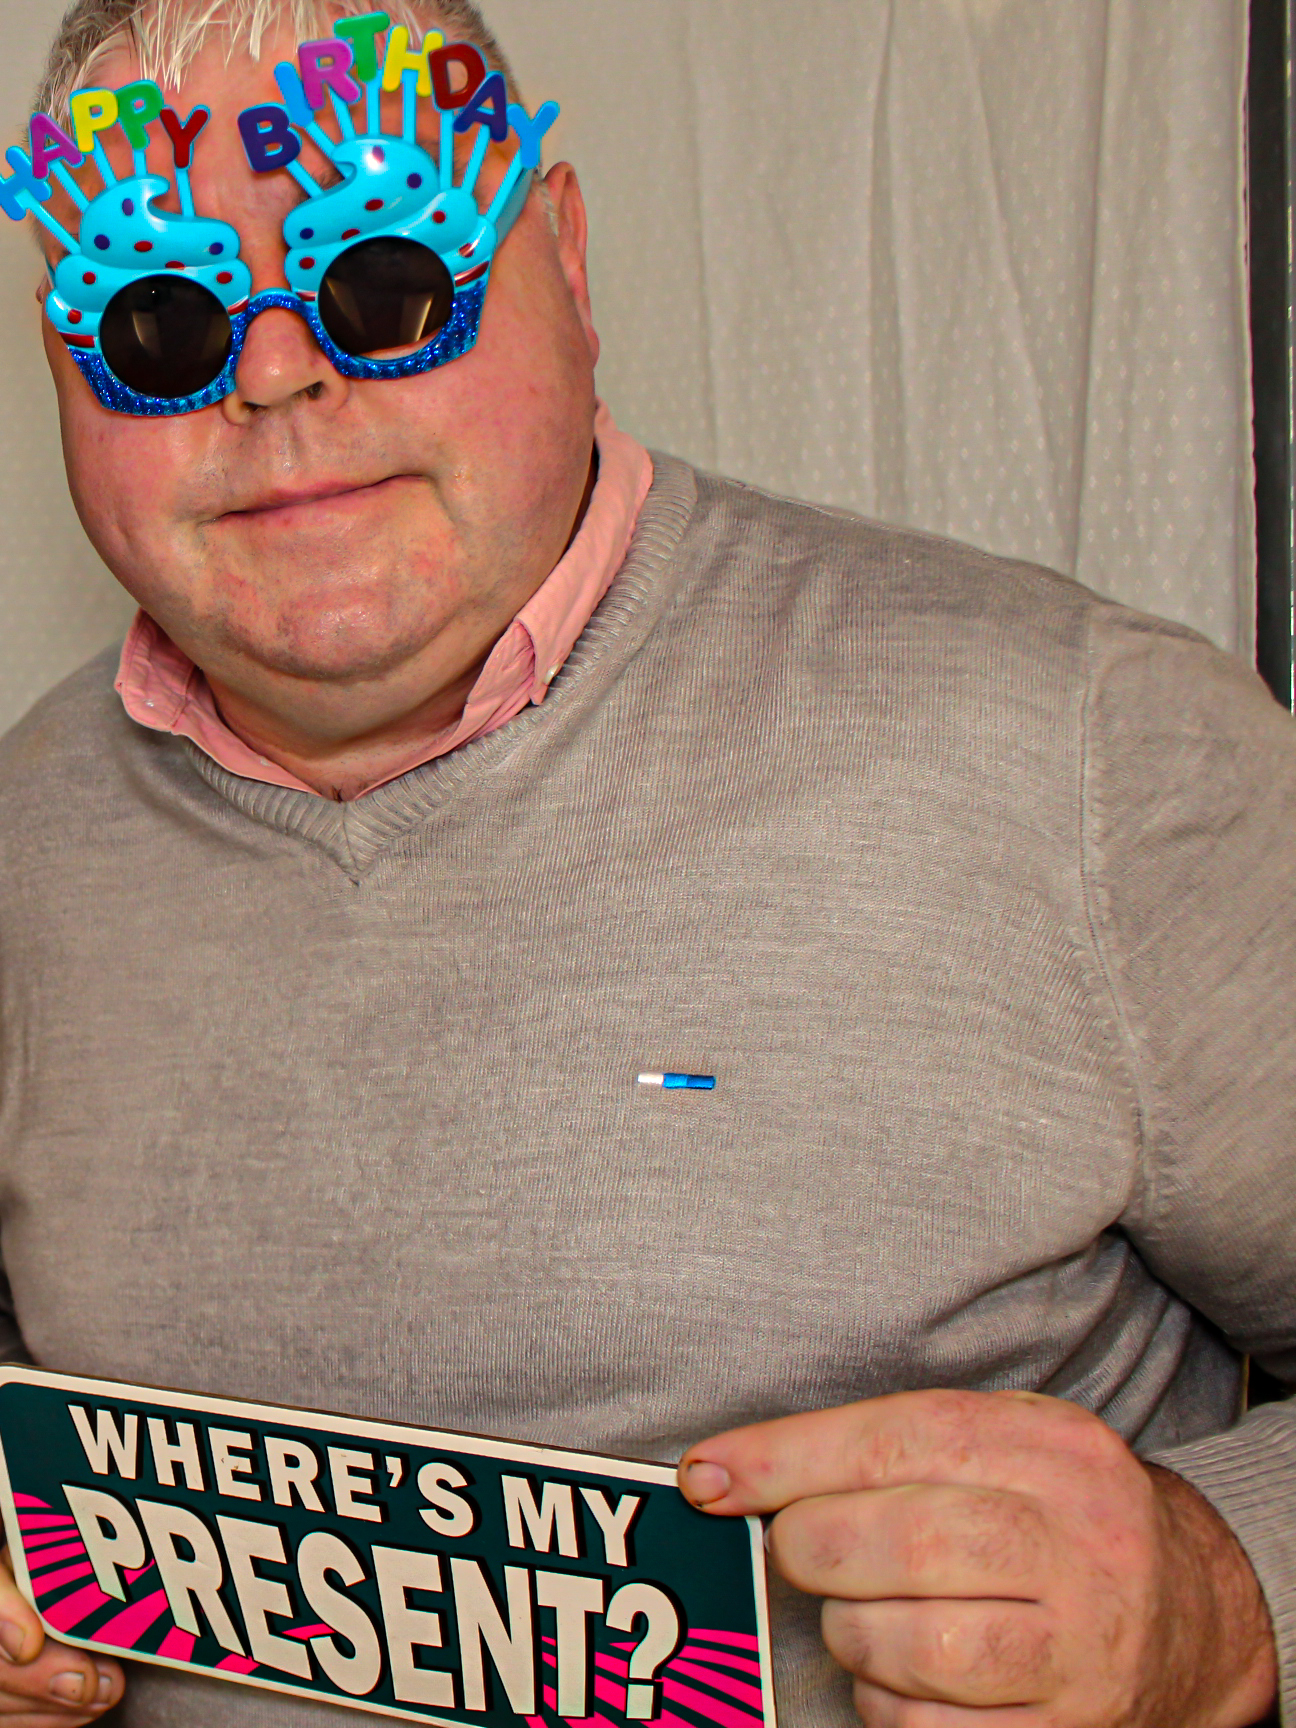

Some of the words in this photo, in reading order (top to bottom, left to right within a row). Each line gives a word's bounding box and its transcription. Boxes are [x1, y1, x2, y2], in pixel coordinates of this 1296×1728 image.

[237, 11, 561, 174] BIRTHDAY
[67, 1403, 478, 1538] WHERE'S
[500, 1473, 642, 1568] MY
[60, 1483, 682, 1721] PRESENT?
